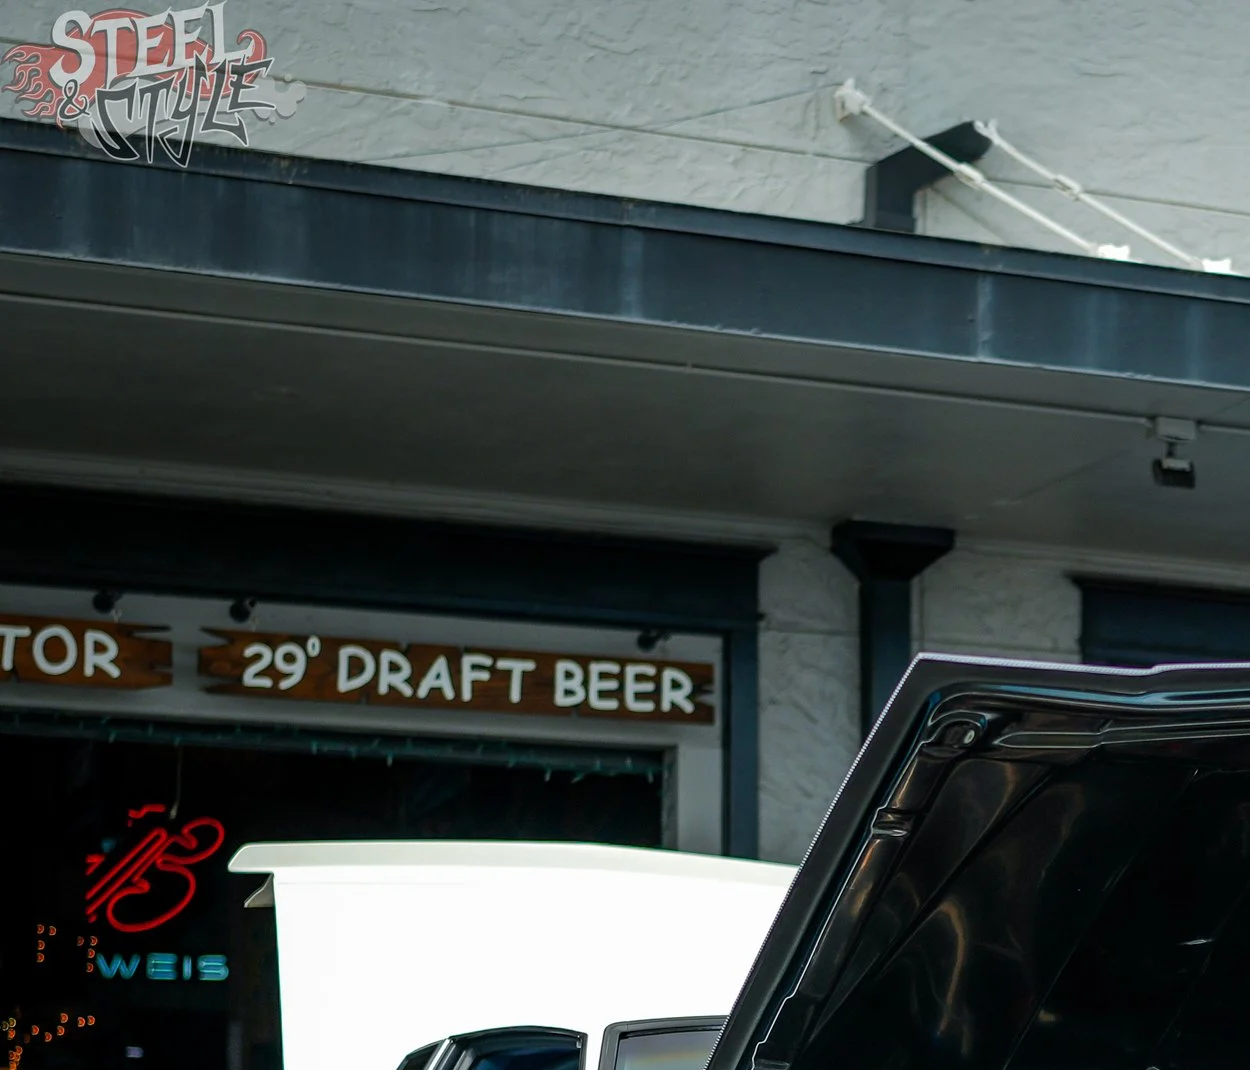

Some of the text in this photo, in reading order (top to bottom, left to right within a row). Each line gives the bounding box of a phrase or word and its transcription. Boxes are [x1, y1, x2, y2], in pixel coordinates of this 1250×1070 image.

[0, 624, 121, 679] TOR
[336, 644, 537, 704] DRAFT
[553, 657, 696, 715] BEER
[96, 952, 230, 981] WEIS
